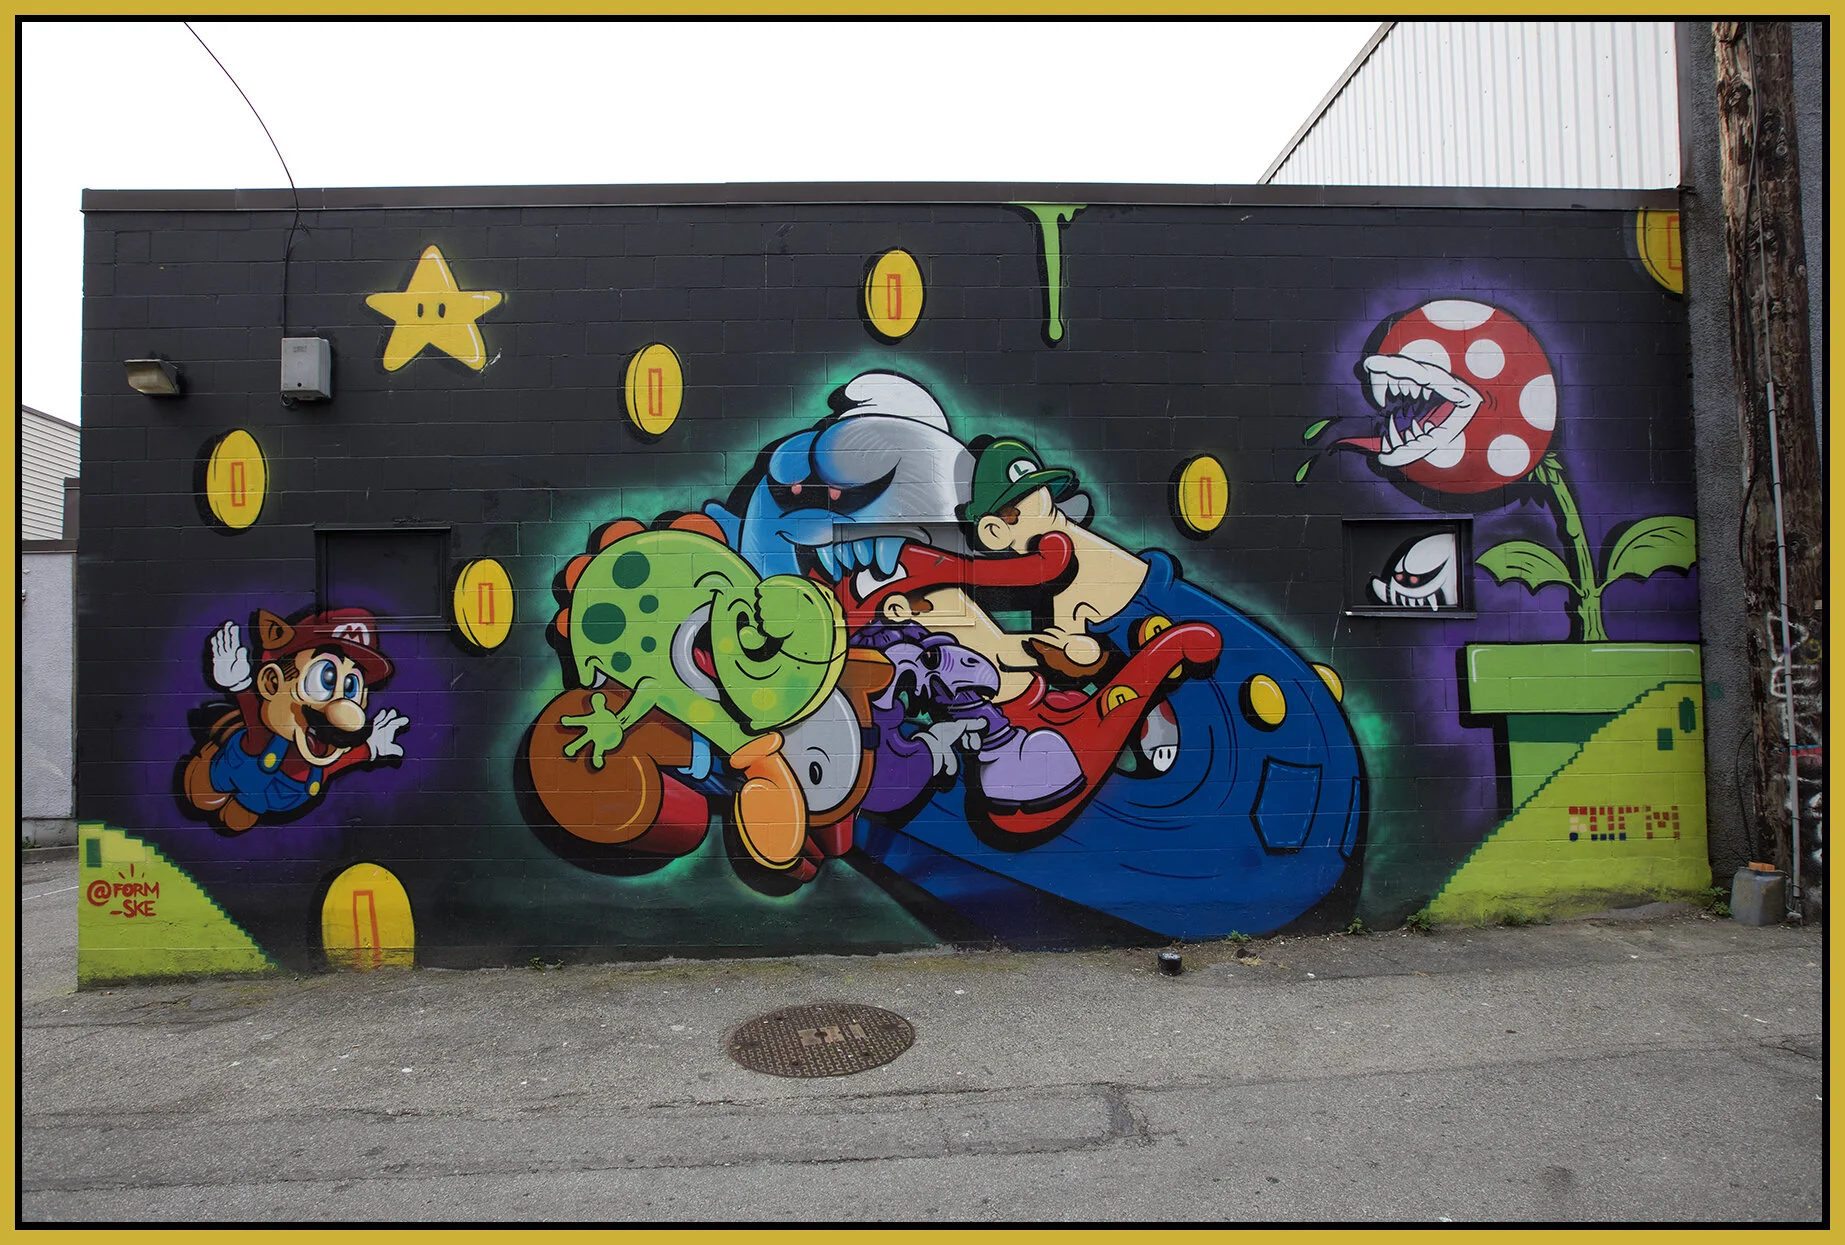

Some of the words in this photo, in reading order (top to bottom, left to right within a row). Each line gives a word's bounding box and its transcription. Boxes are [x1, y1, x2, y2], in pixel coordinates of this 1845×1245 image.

[1013, 463, 1029, 477] L
[340, 624, 365, 644] M
[87, 879, 160, 907] @FORM
